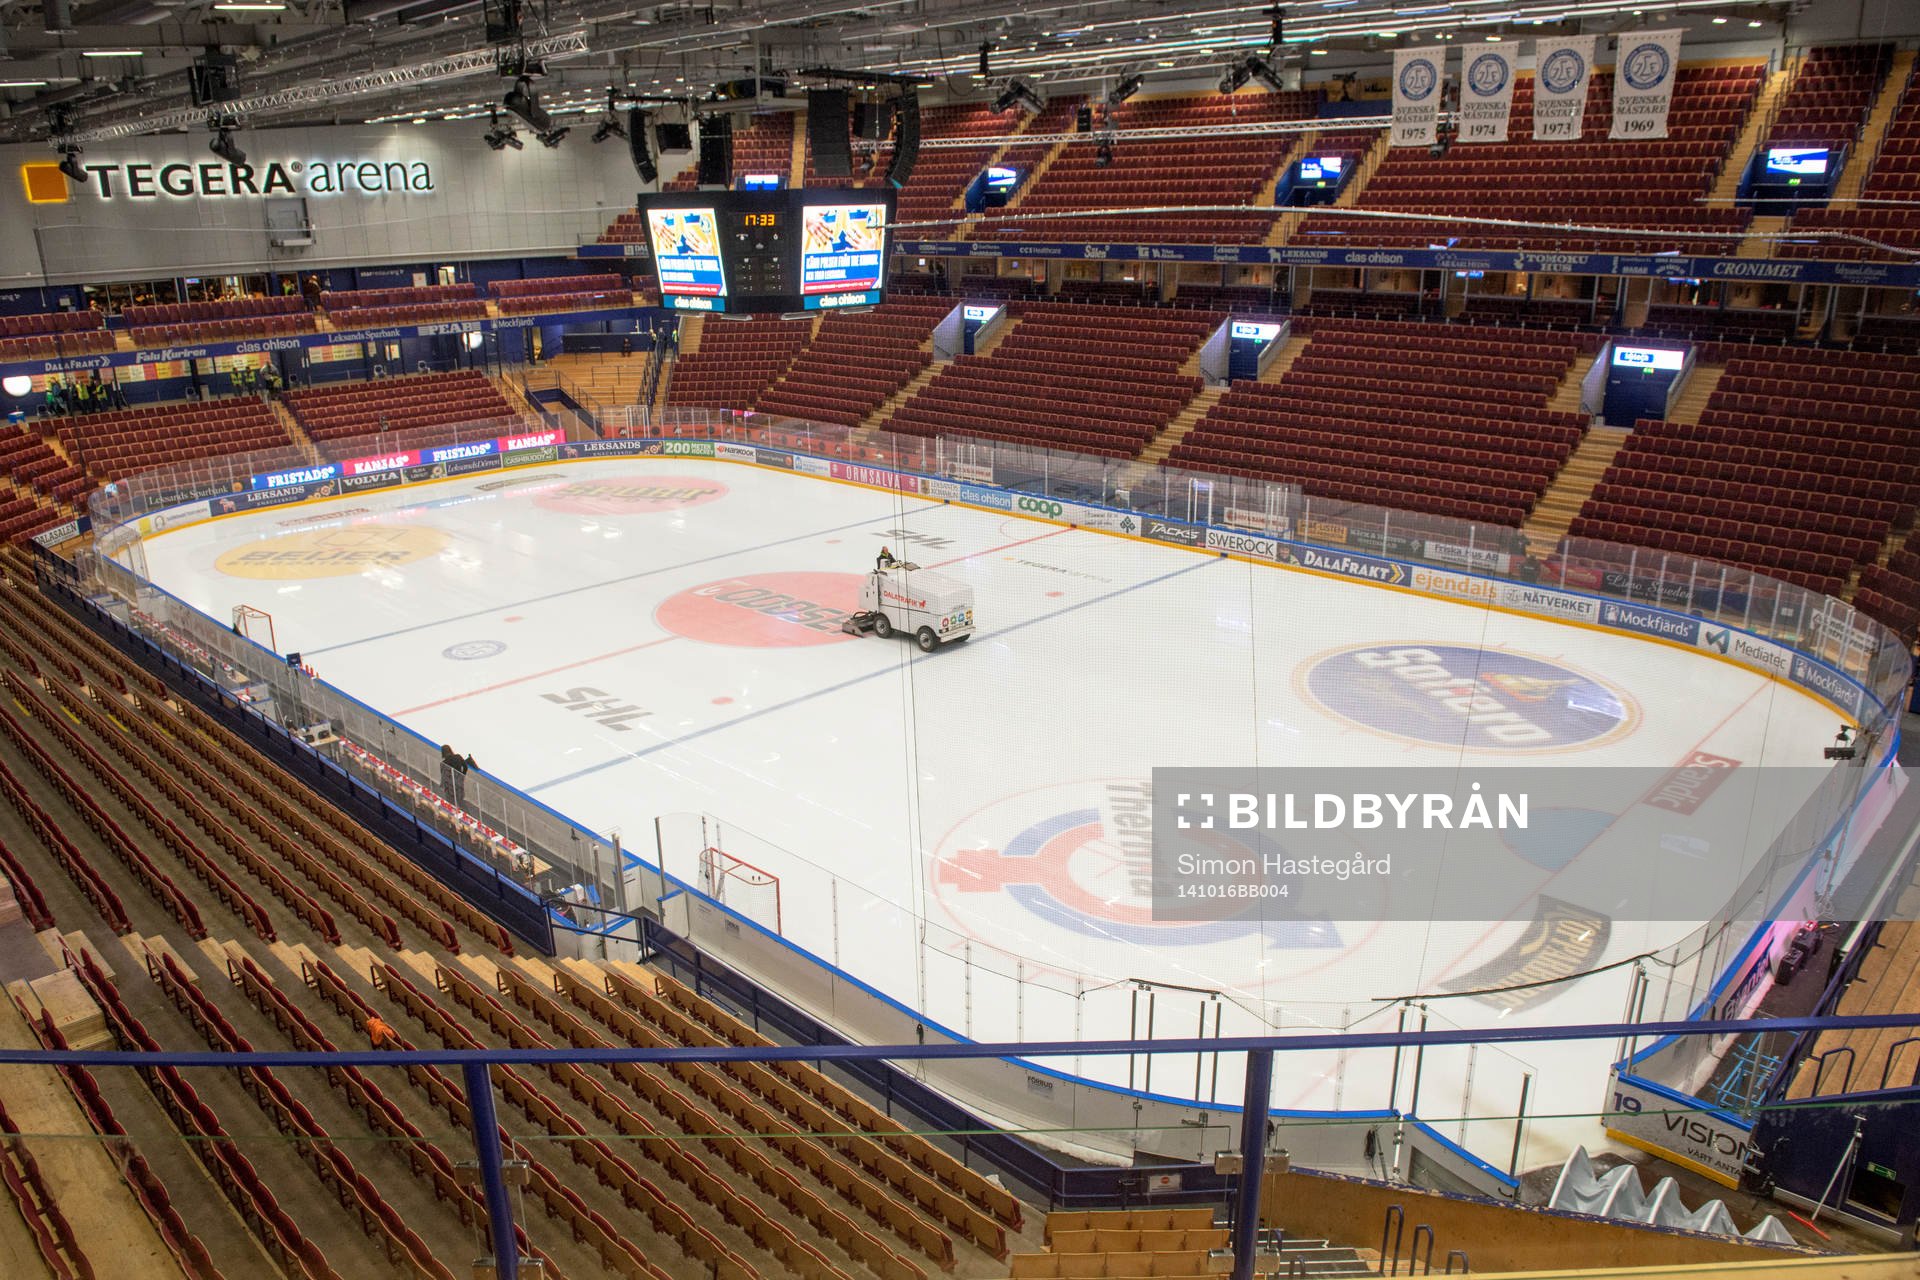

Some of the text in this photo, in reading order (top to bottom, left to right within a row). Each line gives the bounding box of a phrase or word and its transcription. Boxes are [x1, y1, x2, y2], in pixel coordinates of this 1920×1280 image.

[1465, 102, 1507, 111] SVENSKA
[1538, 99, 1582, 109] SVENSKA
[1619, 95, 1667, 105] SVENSKA
[1397, 105, 1436, 115] SVENSKA
[1401, 128, 1426, 141] 1975
[1470, 125, 1497, 137] 1974
[1543, 123, 1571, 136] 1973
[1624, 120, 1655, 134] 1969
[309, 160, 435, 193] arena
[745, 214, 776, 227] 17:33
[1345, 253, 1404, 265] clas ohlson
[1526, 255, 1589, 266] TOMOKU
[1713, 262, 1804, 278] CRONIMET
[674, 296, 713, 310] clas ohlson
[820, 292, 867, 308] clas ohlson
[429, 322, 473, 335] PEAB
[236, 337, 300, 354] clas ohlson
[136, 348, 207, 364] Falu Kuriren
[584, 441, 641, 453] LEKSANDS
[665, 442, 690, 455] 200
[267, 469, 328, 488] FRISTADS
[343, 472, 399, 487] VOLVIA
[846, 466, 901, 490] ORMSALVA
[247, 486, 305, 502] LEKSANDS
[962, 490, 980, 502] clas
[981, 493, 1011, 508] ohlson
[1018, 496, 1063, 519] coop
[1151, 522, 1200, 540] TACKS
[1208, 531, 1274, 557] SWEROCK
[240, 551, 412, 562] BEIJER
[1416, 572, 1498, 600] ejendals
[1523, 590, 1593, 615] NÄTVERKET
[1620, 610, 1691, 639] Mockfjärds
[1736, 639, 1787, 671] Mediatec
[540, 686, 655, 732] SHL
[1614, 1091, 1642, 1117] 19
